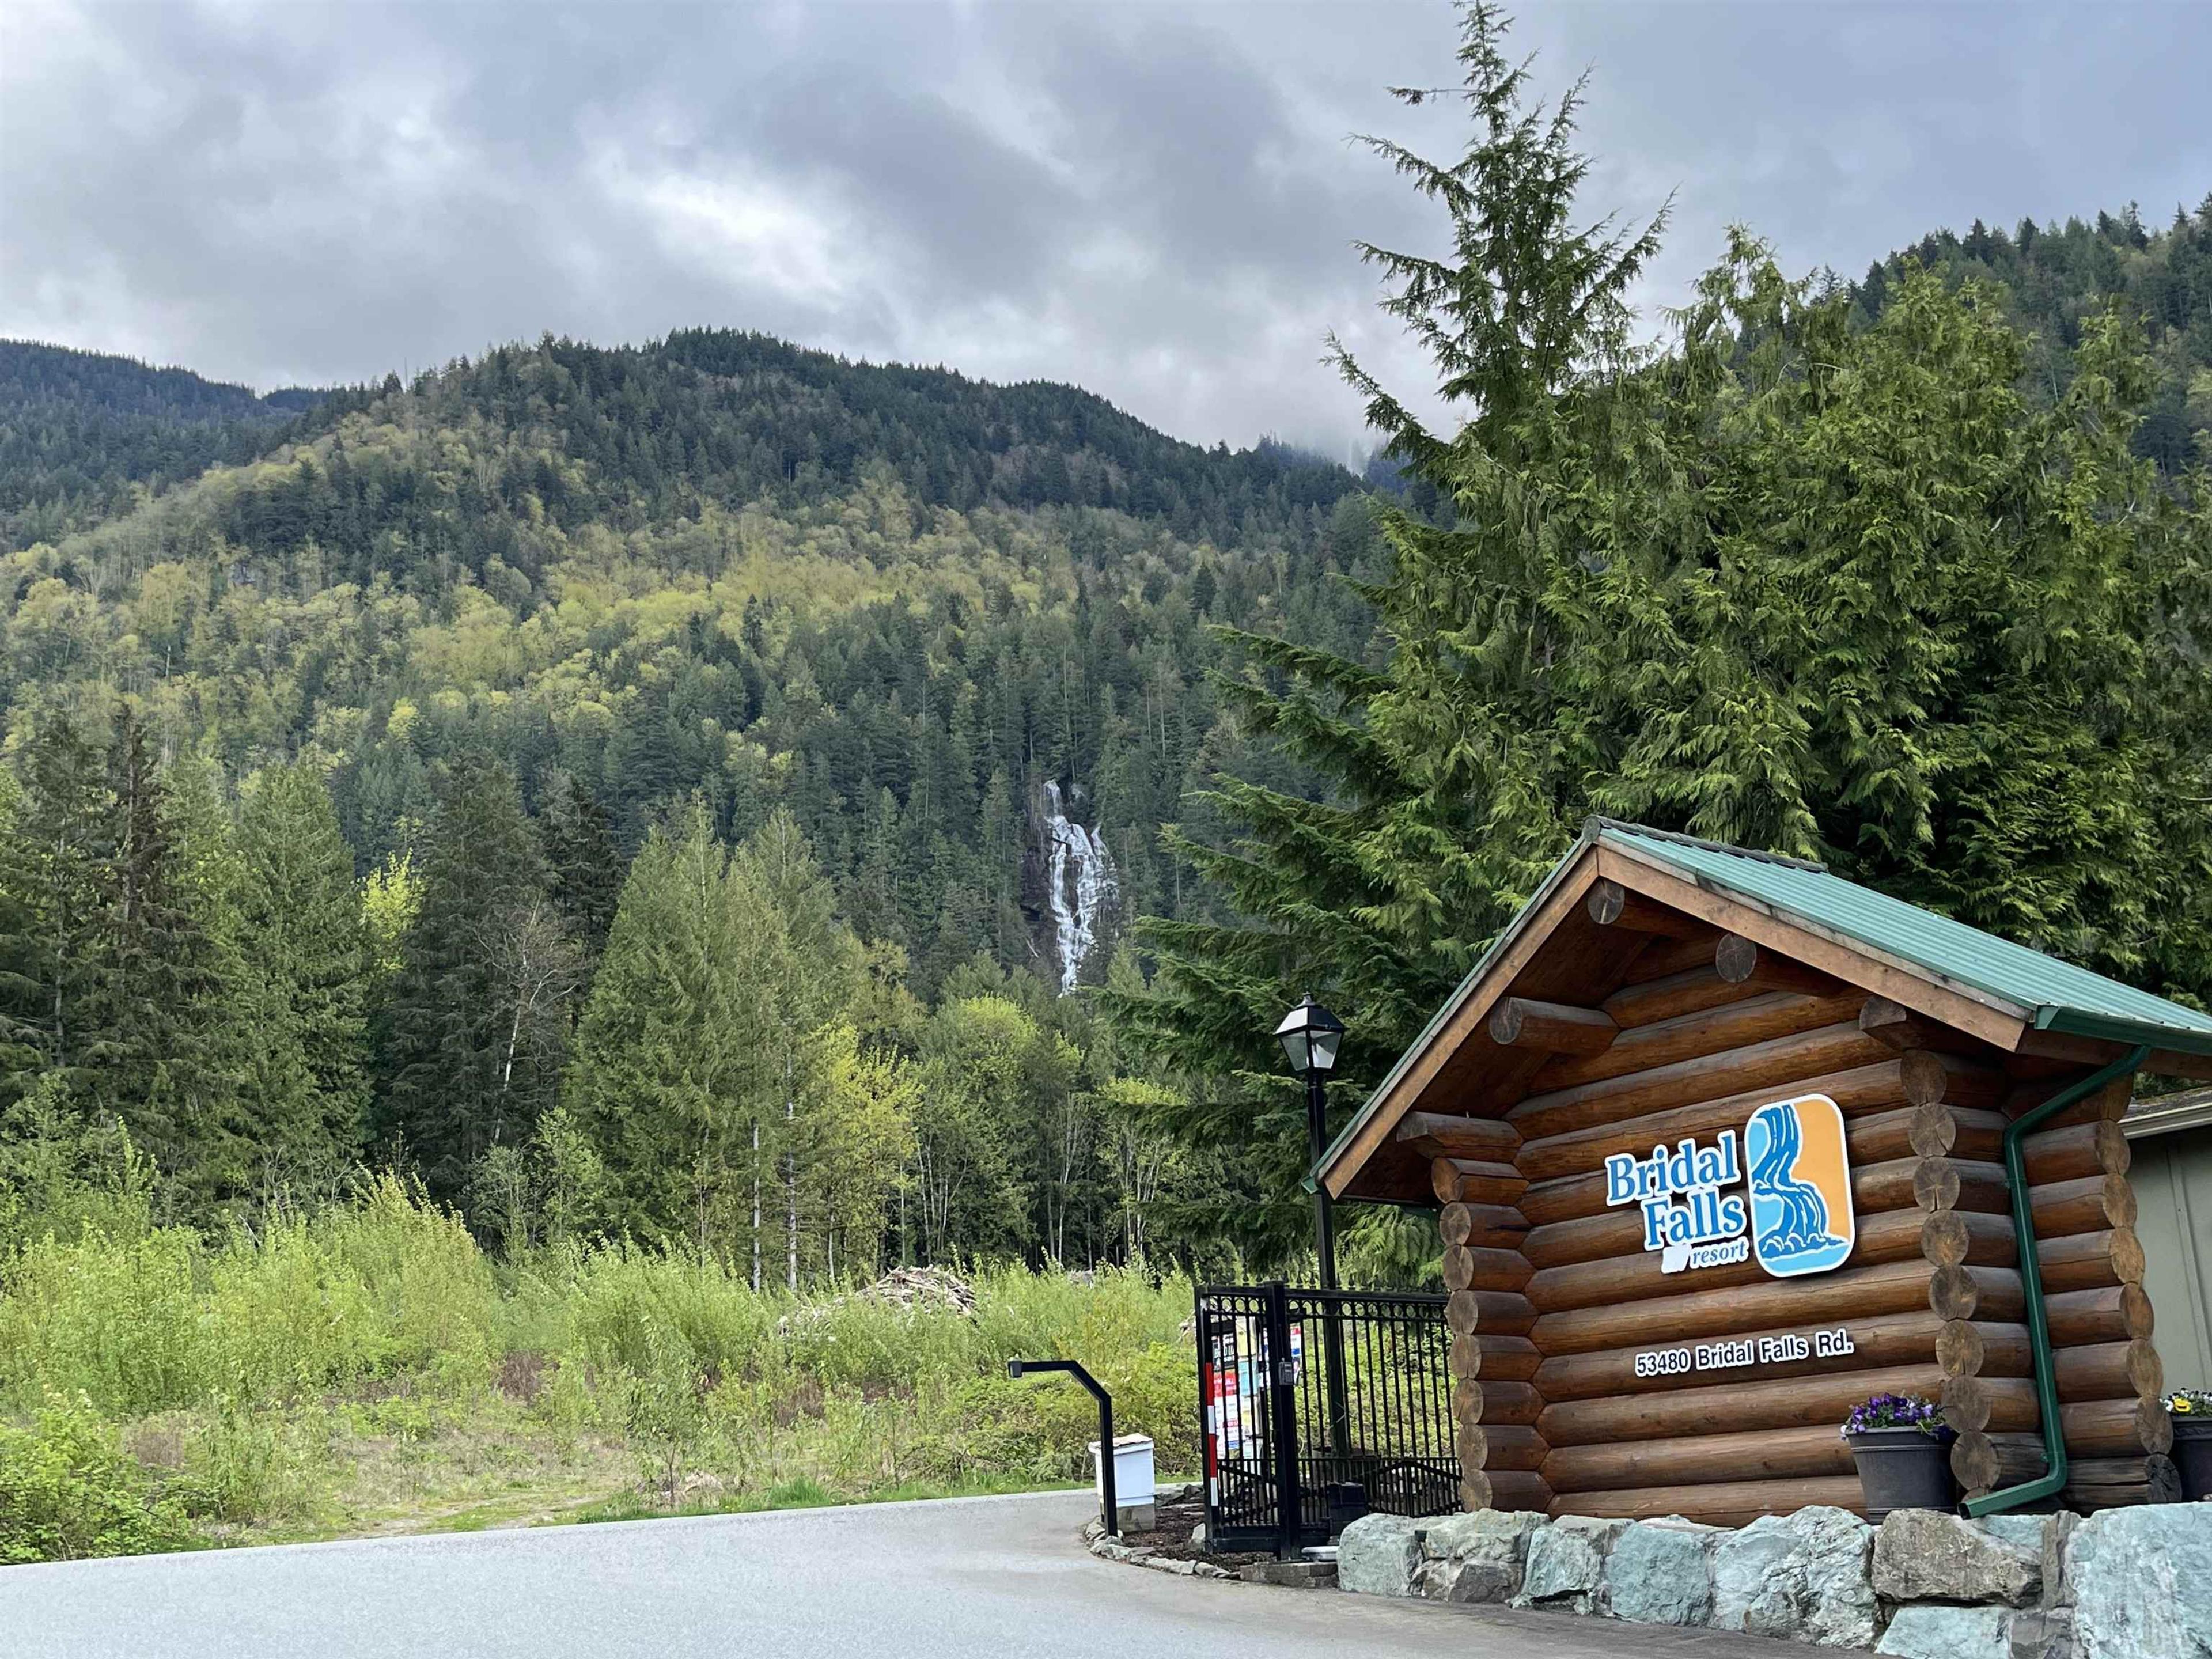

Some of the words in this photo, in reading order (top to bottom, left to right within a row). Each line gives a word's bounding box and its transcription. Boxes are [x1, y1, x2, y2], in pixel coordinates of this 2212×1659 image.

[1608, 1134, 1737, 1201] Bridal
[1645, 1191, 1744, 1247] Falls
[1692, 1241, 1745, 1264] resort
[1637, 1351, 1688, 1374] 53480
[1697, 1342, 1752, 1367] Bridal
[1760, 1337, 1808, 1360] Falls
[1818, 1331, 1852, 1354] Rd.
